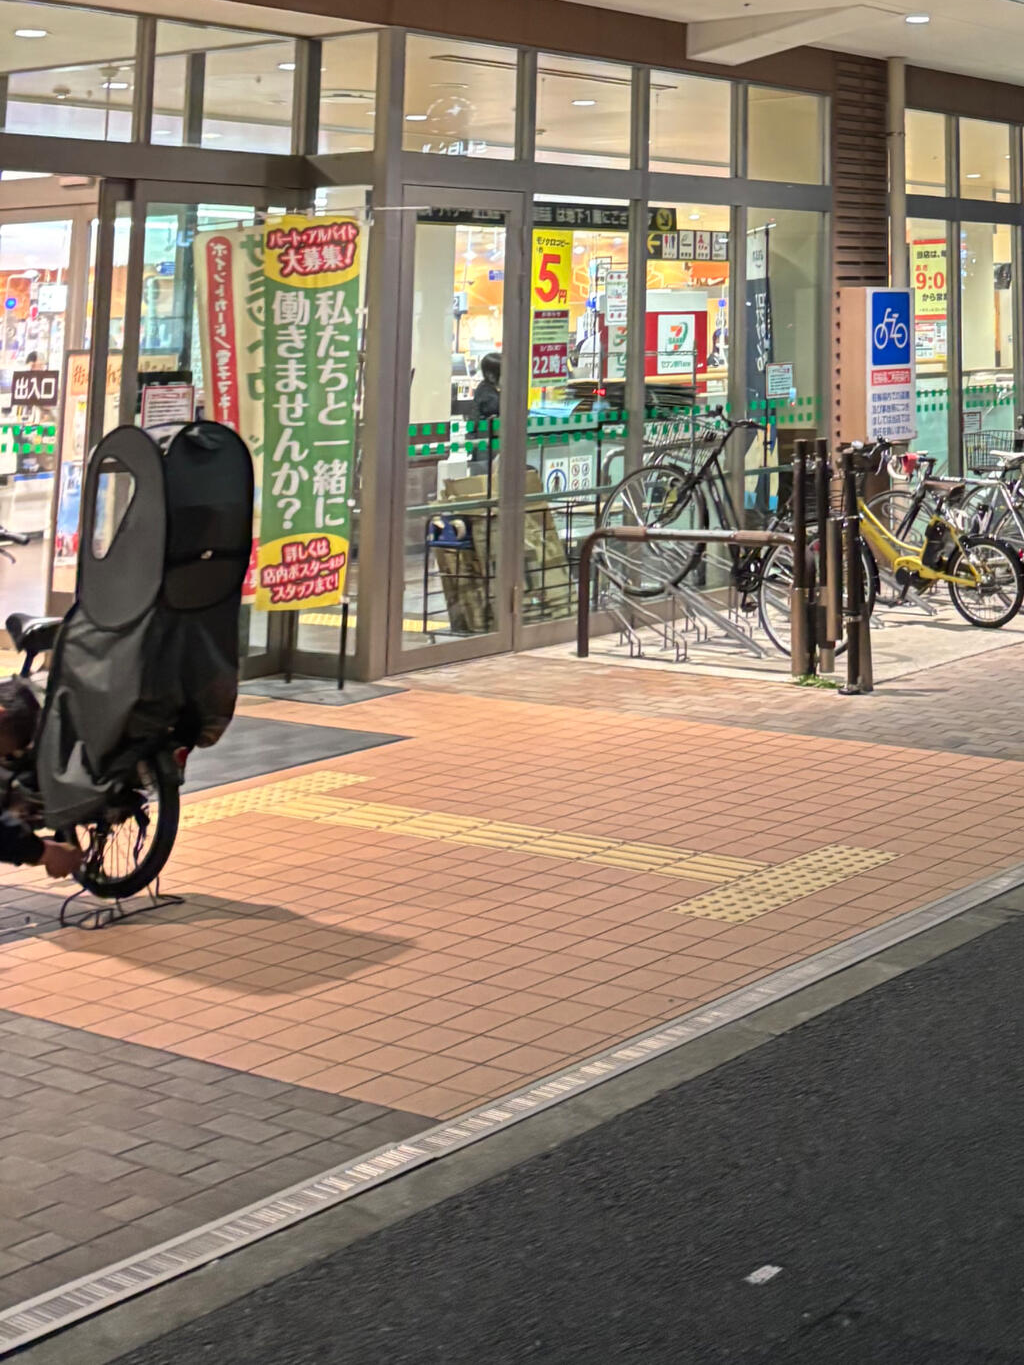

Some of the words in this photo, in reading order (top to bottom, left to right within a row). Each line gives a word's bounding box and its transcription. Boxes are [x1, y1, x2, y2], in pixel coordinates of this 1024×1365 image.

[269, 223, 358, 248] パート・アルバイト
[916, 272, 946, 290] 9:0
[14, 377, 56, 401] 出入口
[271, 290, 311, 530] 働きませんか?
[312, 290, 352, 528] 私たちと一緒に
